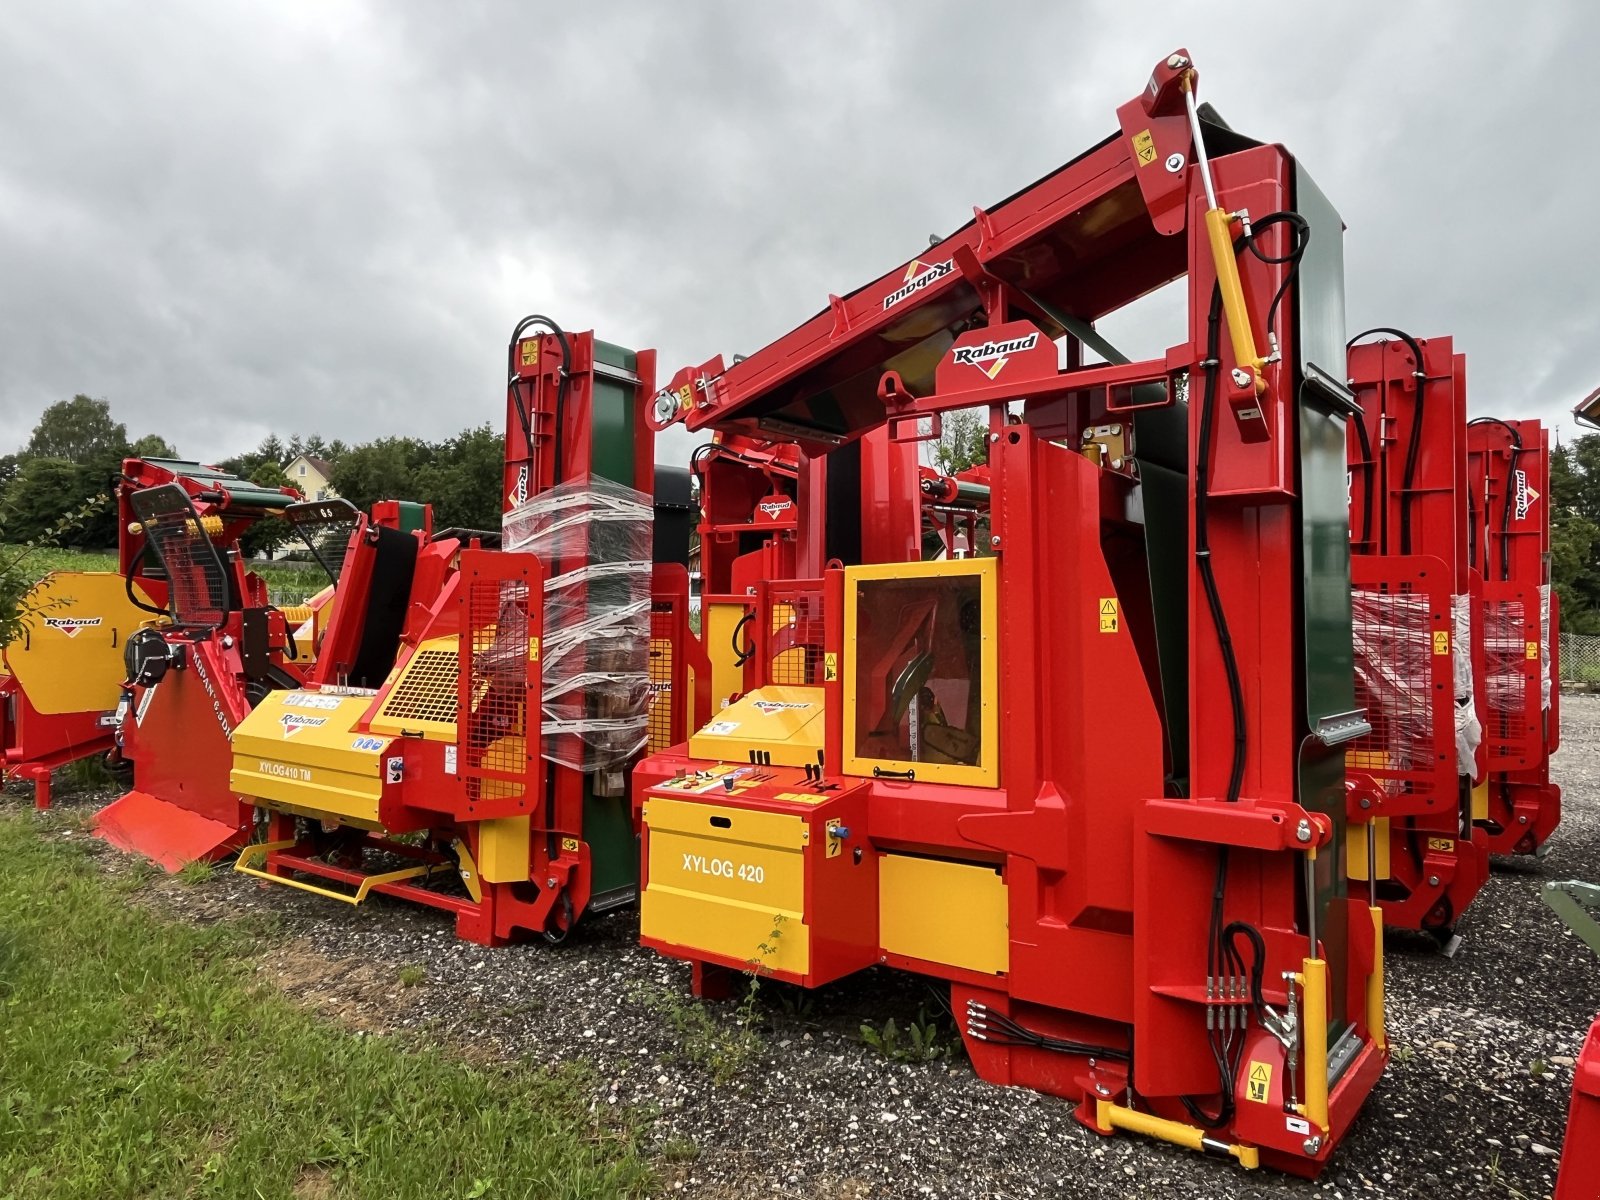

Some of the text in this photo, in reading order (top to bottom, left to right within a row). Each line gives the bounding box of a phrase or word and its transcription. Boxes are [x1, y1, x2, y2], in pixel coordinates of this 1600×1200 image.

[884, 260, 953, 308] Rabaud
[955, 335, 1036, 364] Rabaud
[1517, 471, 1526, 520] Rabaud
[761, 502, 790, 511] Rabaud
[46, 618, 101, 627] Rabaud
[281, 714, 327, 725] Rabaud
[300, 769, 311, 781] TM
[682, 853, 764, 884] XYLOG 420
